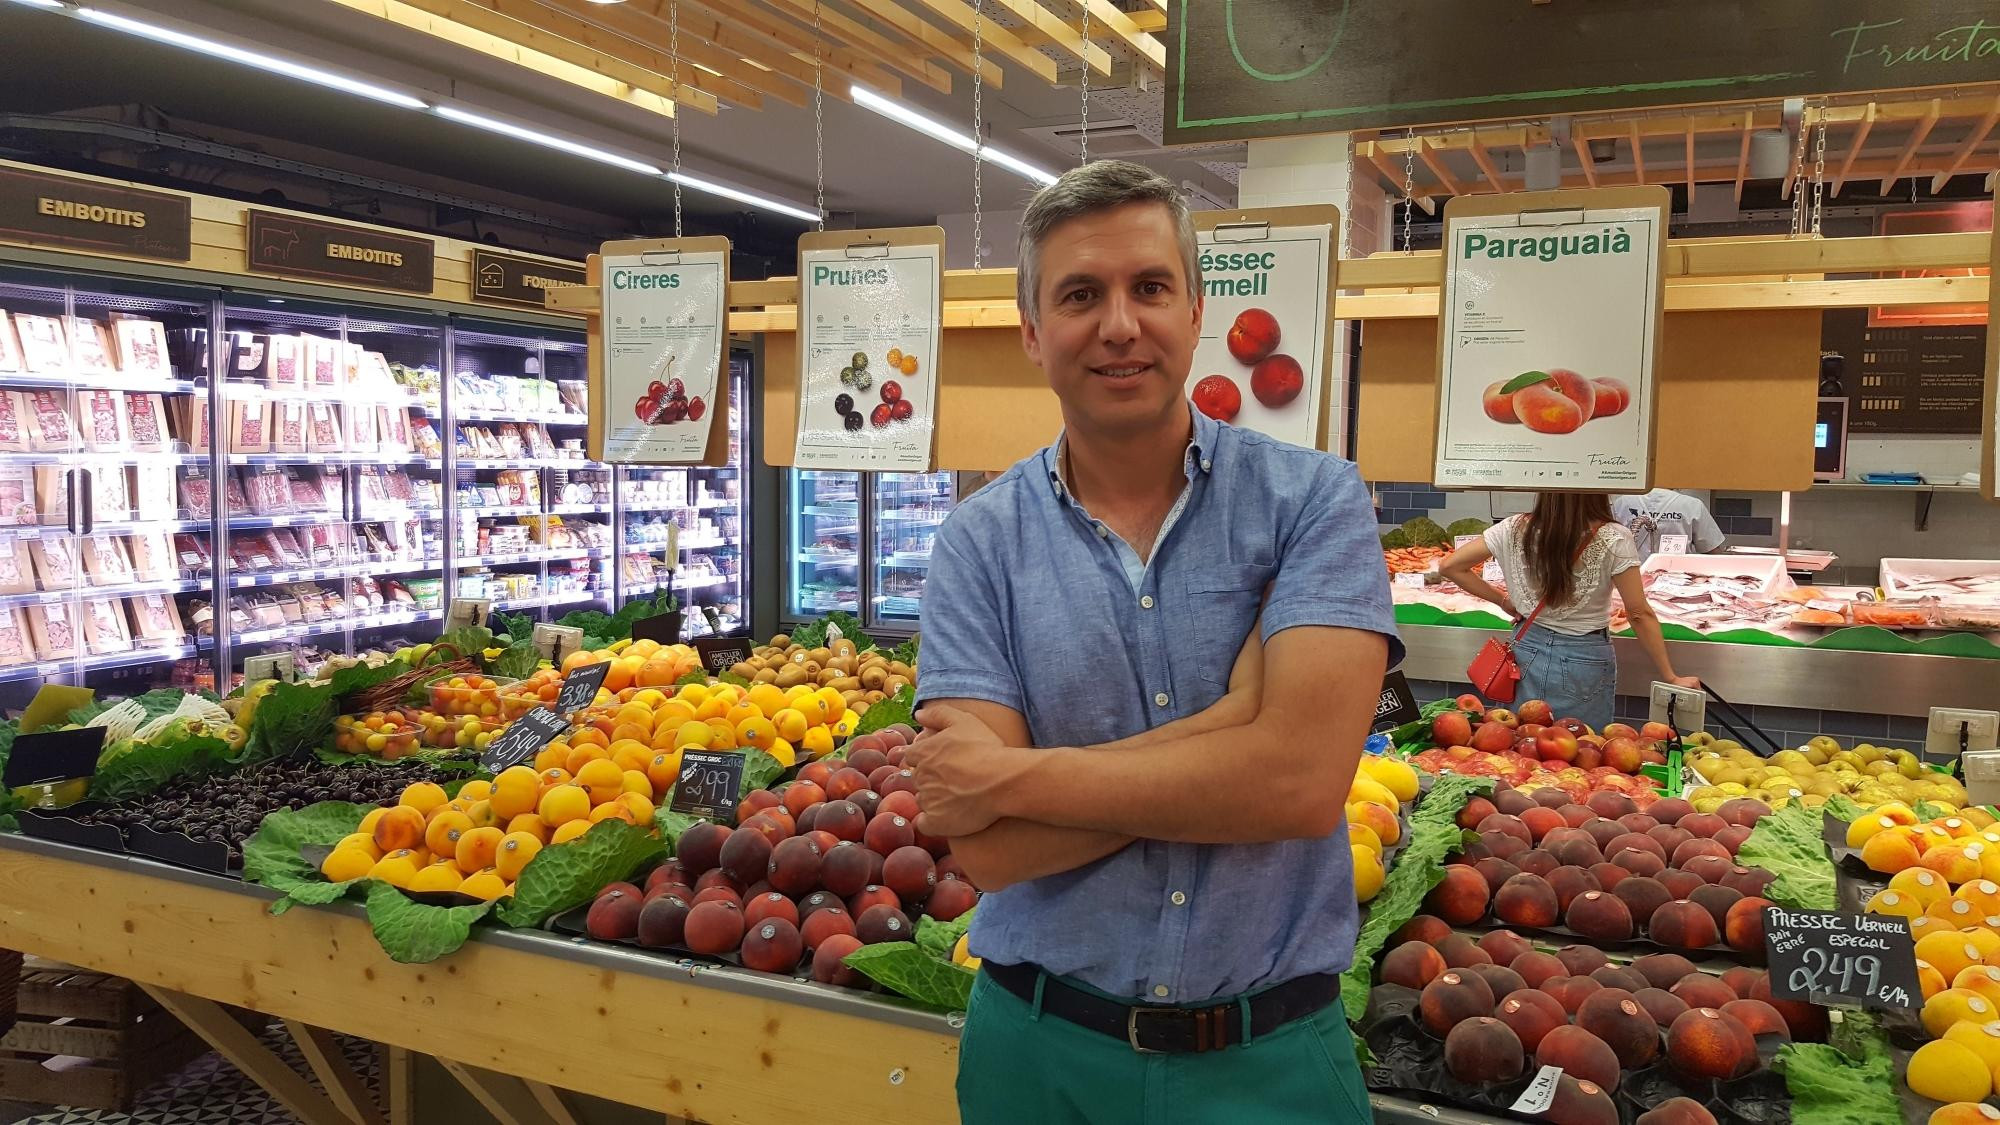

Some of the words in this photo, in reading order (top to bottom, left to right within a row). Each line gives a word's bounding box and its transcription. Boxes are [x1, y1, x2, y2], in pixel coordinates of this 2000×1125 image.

[1830, 18, 2000, 74] Fruita
[38, 197, 146, 228] EMBOTITS
[326, 243, 403, 267] EMBOTITS
[1464, 227, 1631, 262] Paraguaià
[1200, 248, 1276, 272] éssec
[613, 270, 680, 290] Cireres
[814, 266, 888, 286] Prunes
[1202, 273, 1268, 297] rmell
[1587, 453, 1631, 467] Fruita
[711, 650, 740, 659] AMETLLER
[713, 656, 743, 667] ORIGEN
[1375, 698, 1399, 714] GEN
[686, 767, 730, 805] 2,99
[1788, 947, 1882, 995] 2,49
